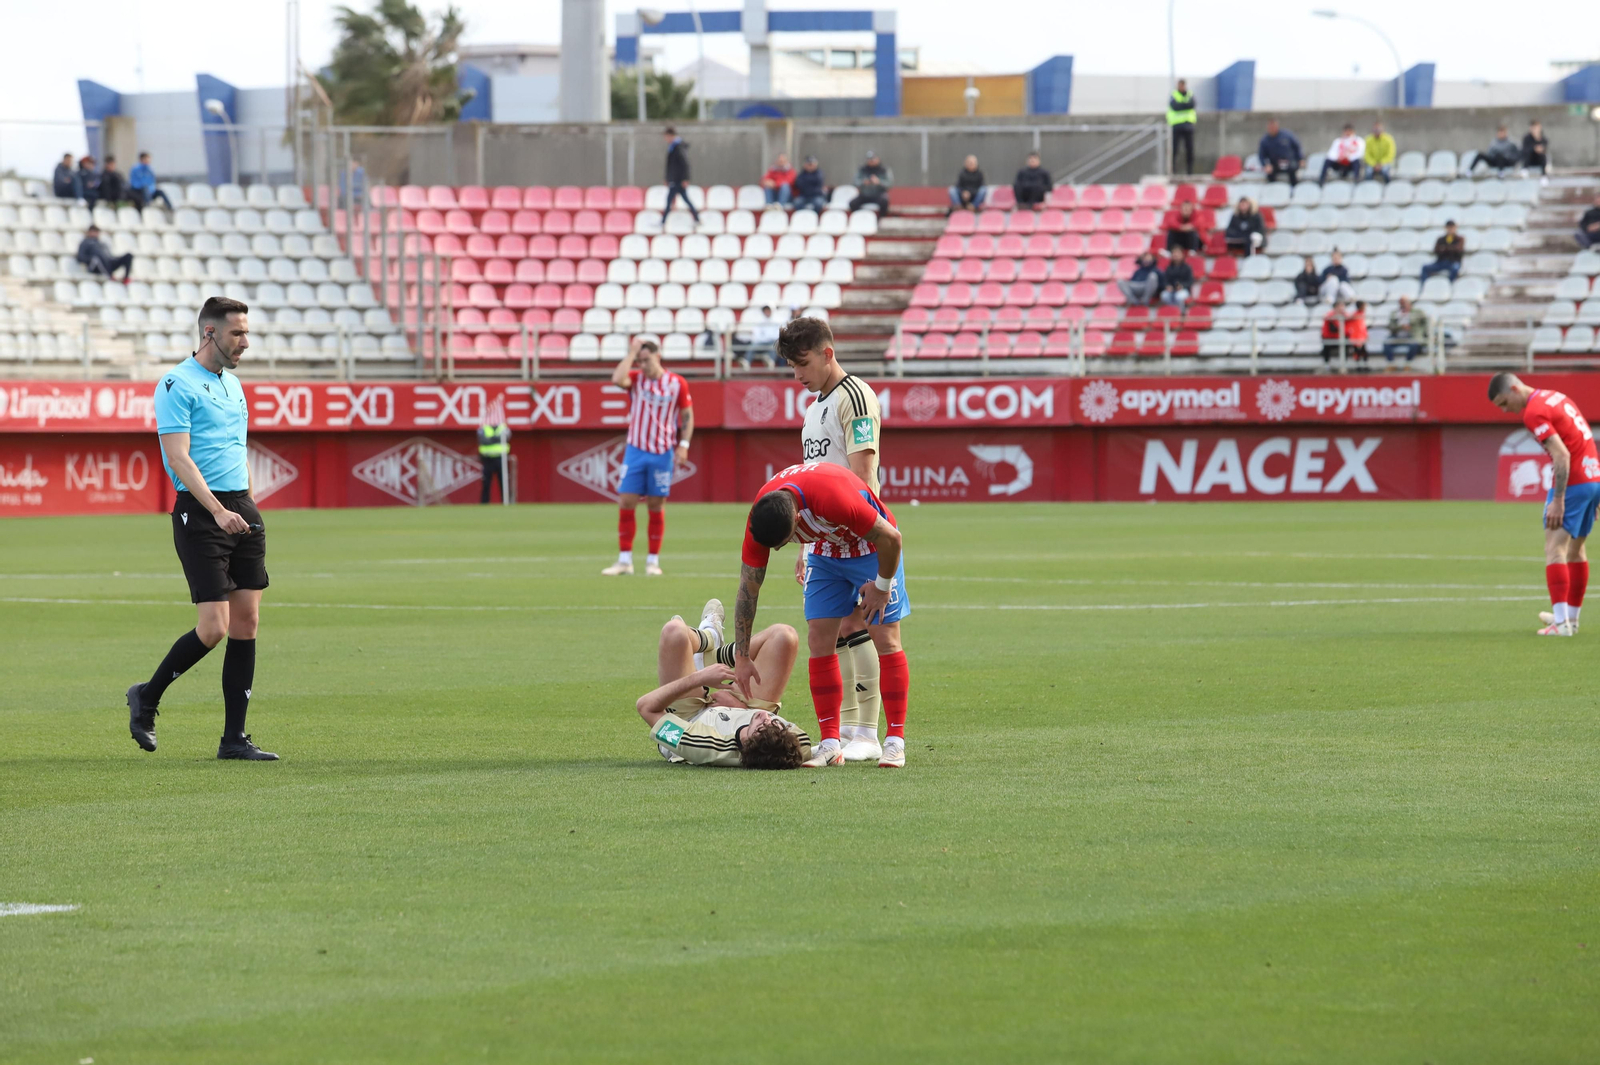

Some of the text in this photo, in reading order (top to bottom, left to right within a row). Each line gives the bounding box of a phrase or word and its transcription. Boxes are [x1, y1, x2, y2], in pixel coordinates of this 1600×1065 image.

[253, 386, 313, 426] EXO
[325, 386, 394, 426] EXO
[504, 385, 581, 425] EXO
[946, 384, 1054, 420] ICOM
[1120, 381, 1241, 416] apymeal
[1299, 379, 1421, 415] apymeal
[64, 450, 149, 491] KAHLO
[1139, 436, 1383, 495] NACEX
